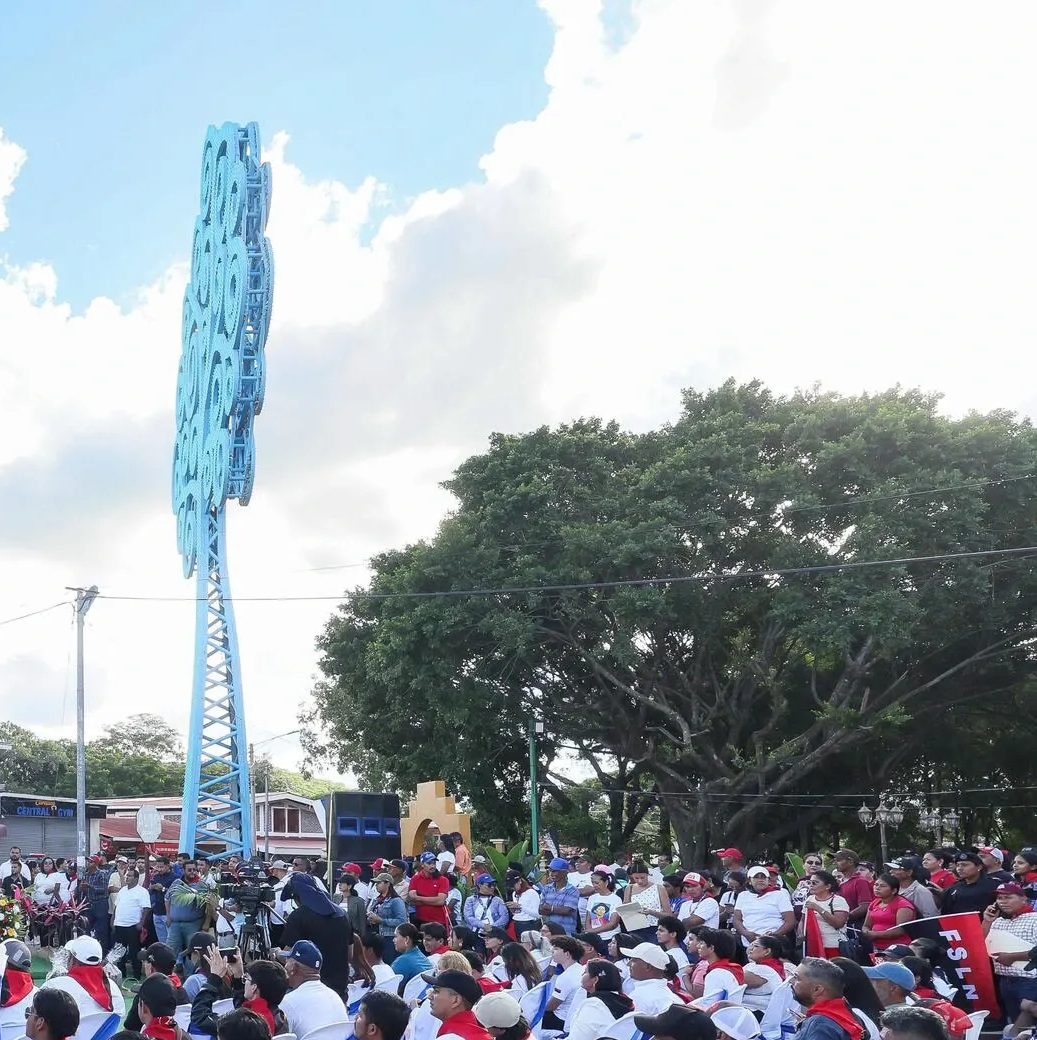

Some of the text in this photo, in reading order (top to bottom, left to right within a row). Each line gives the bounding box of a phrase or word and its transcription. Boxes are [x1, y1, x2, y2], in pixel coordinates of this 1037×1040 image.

[17, 806, 74, 817] CENTRAL GYM
[938, 929, 979, 1000] FSLN
